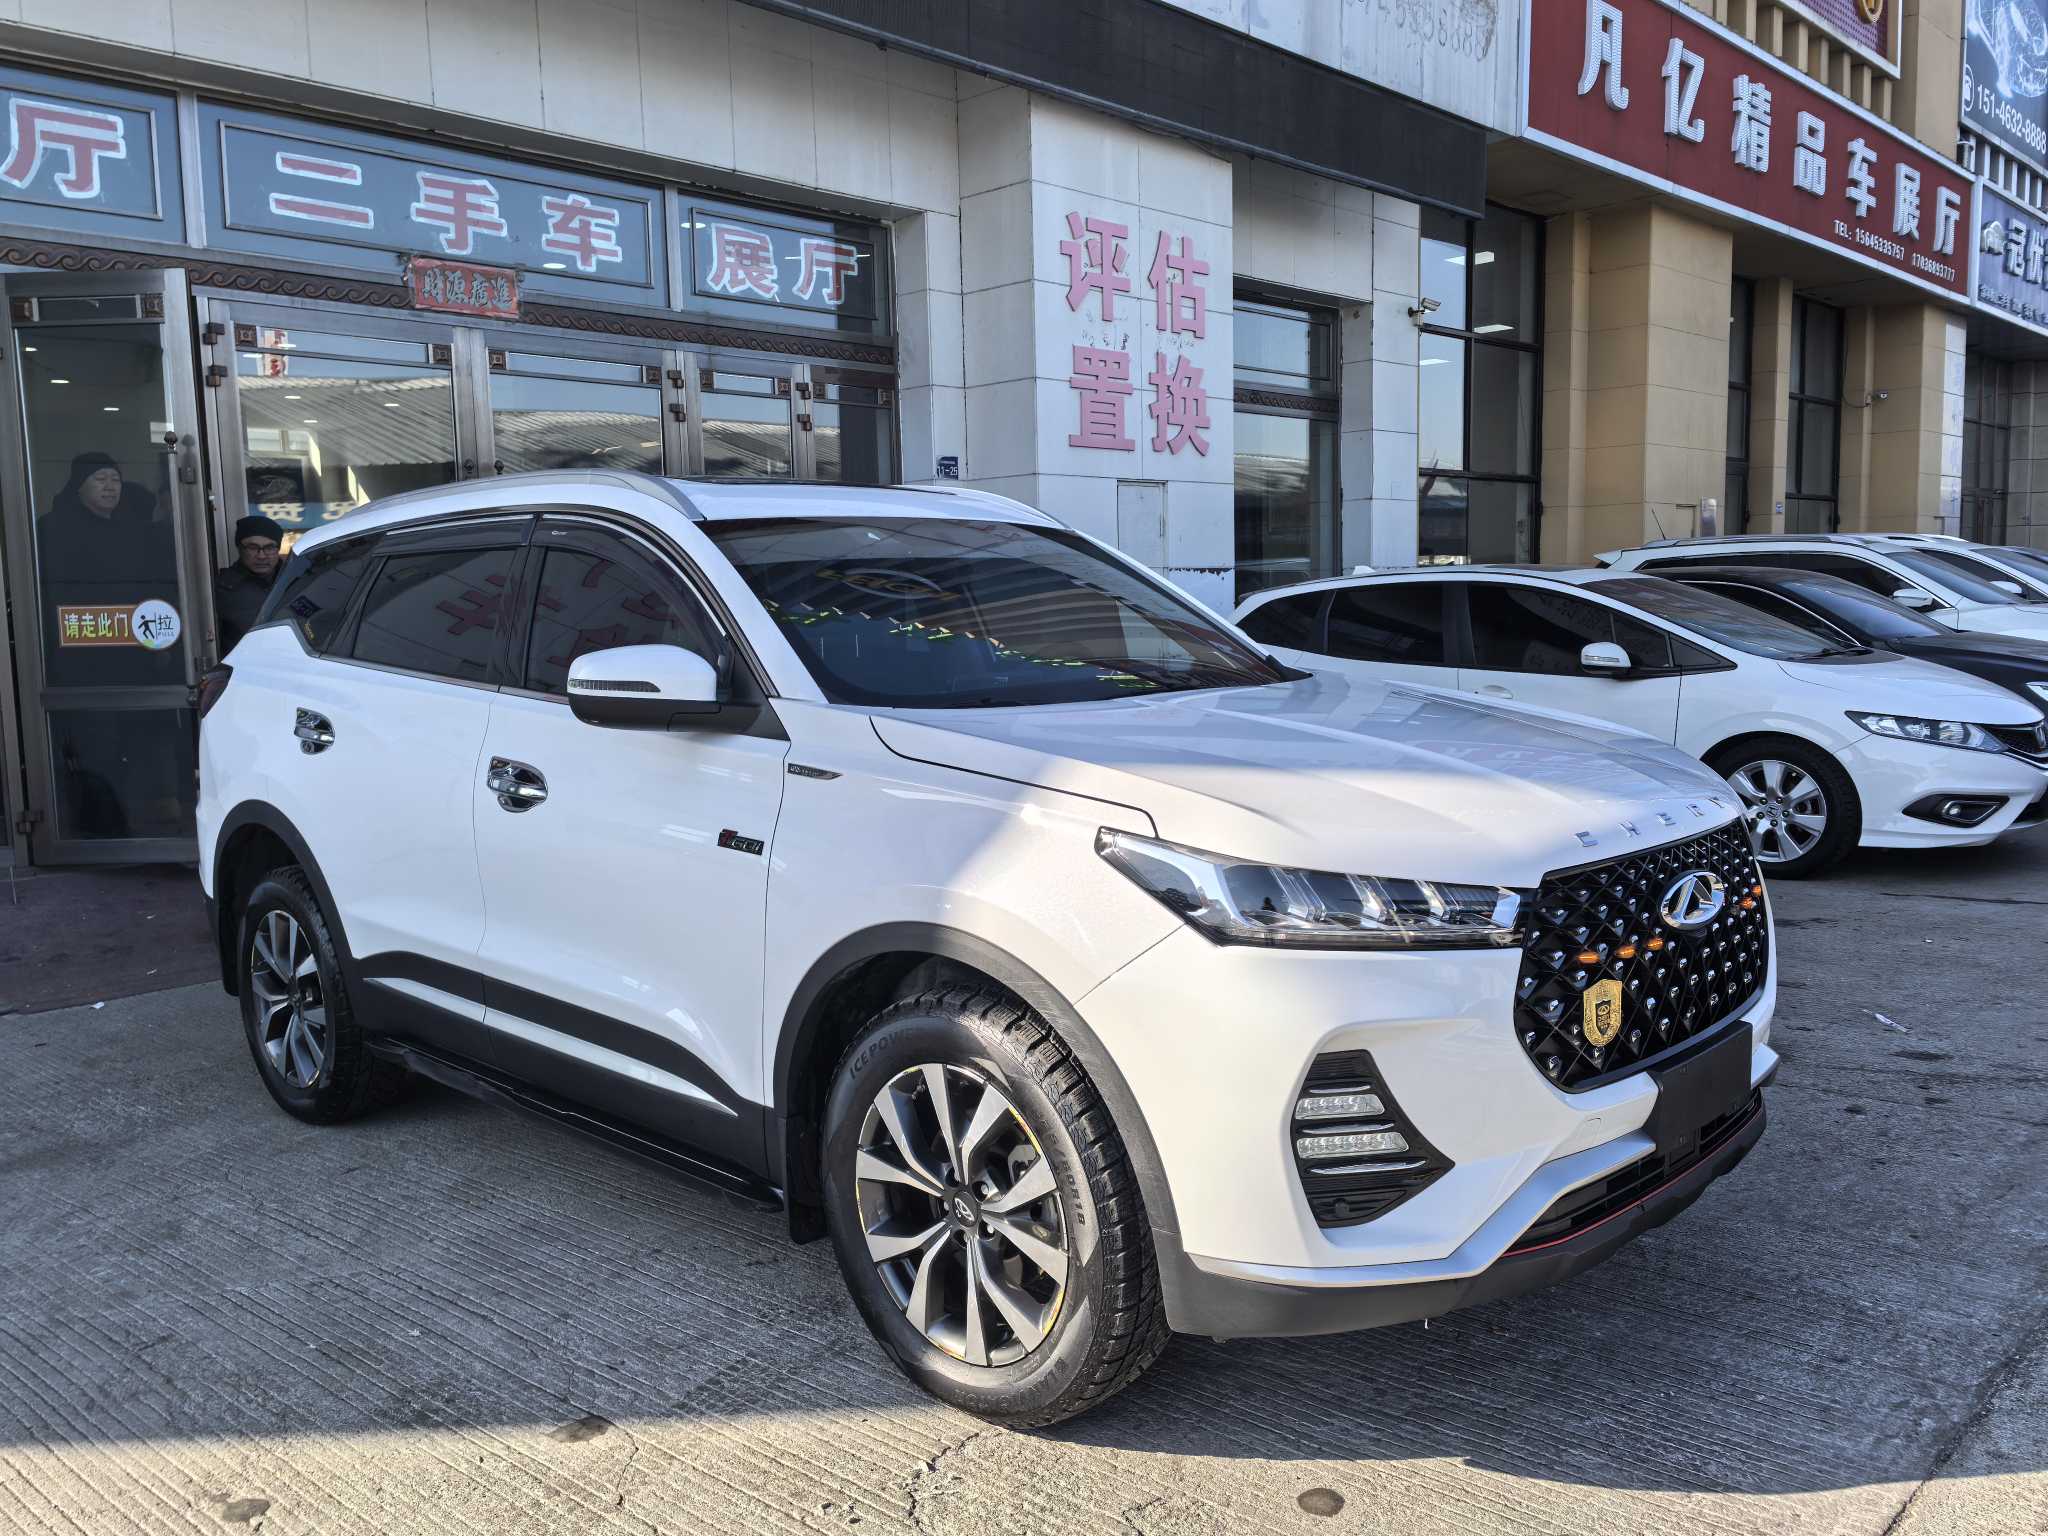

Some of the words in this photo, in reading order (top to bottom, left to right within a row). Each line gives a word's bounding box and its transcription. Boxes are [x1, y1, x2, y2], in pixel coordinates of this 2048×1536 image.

[0, 98, 126, 199] 厅
[1578, 2, 1961, 256] 凡亿精品车展厅
[1977, 84, 2047, 154] 151-4632-8888
[1059, 211, 1209, 339] 评估
[1068, 344, 1210, 457] 置换
[64, 612, 129, 639] 请走此门
[158, 614, 174, 630] 拉
[1574, 796, 1725, 848] CHERY
